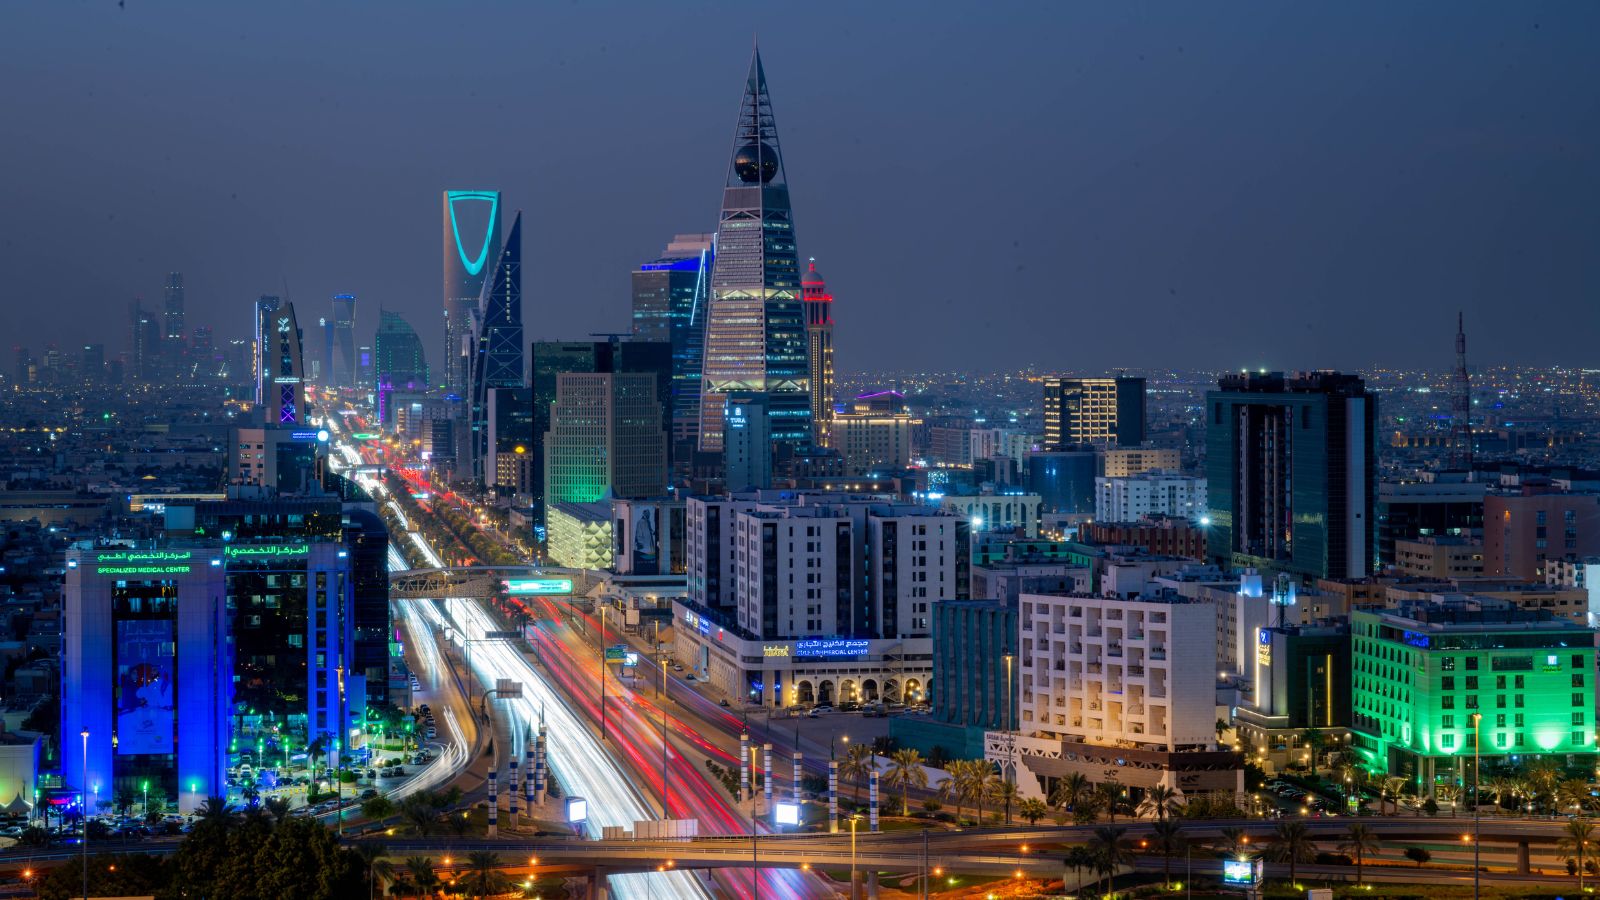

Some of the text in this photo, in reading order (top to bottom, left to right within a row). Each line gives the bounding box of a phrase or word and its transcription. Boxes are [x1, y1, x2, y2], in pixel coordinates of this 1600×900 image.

[230, 545, 276, 558] التخصصي
[275, 545, 309, 556] المركز
[97, 551, 191, 562] المركز التخصصي الطبي
[165, 565, 191, 573] CENTER
